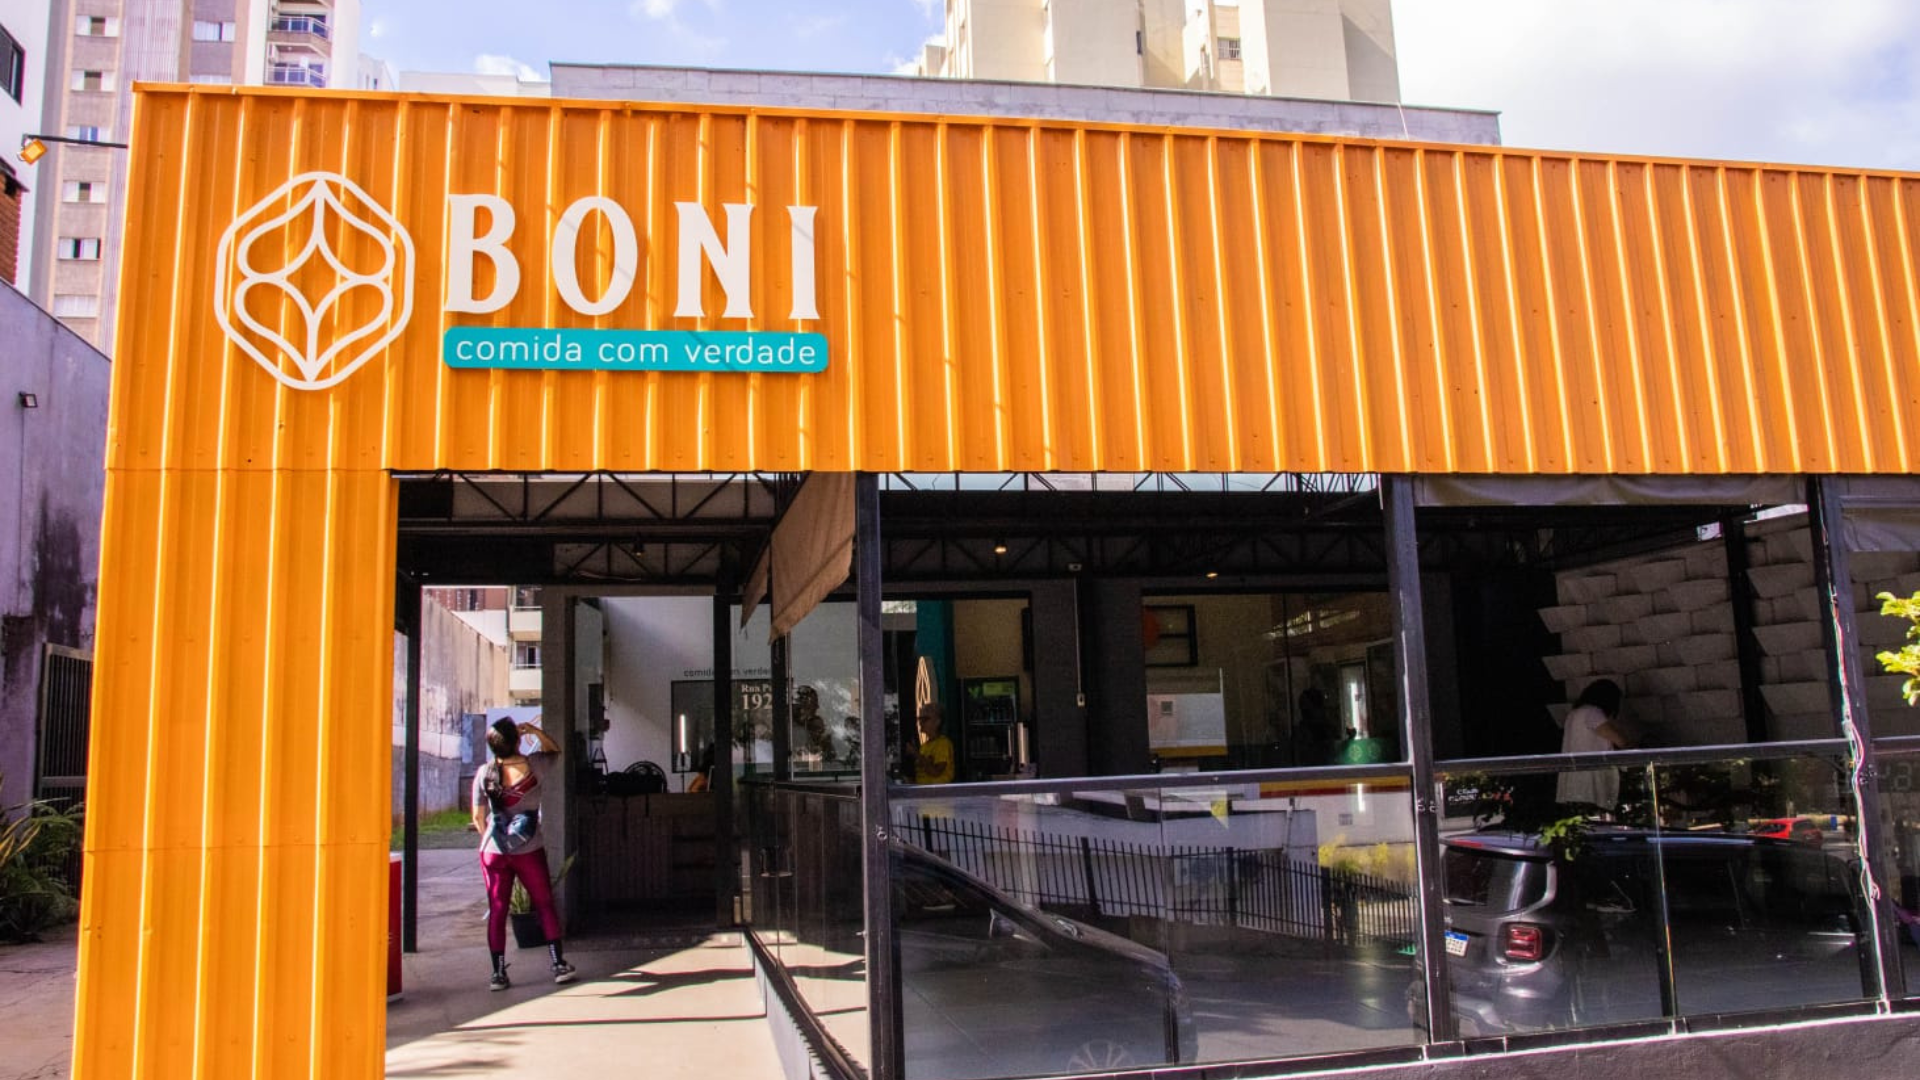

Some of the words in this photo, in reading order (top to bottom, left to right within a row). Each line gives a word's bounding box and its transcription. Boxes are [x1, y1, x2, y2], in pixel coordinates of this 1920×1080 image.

[442, 193, 819, 320] BONI
[455, 334, 582, 363] comida
[598, 342, 668, 363] com
[684, 337, 816, 365] verdade
[742, 693, 773, 710] 192
